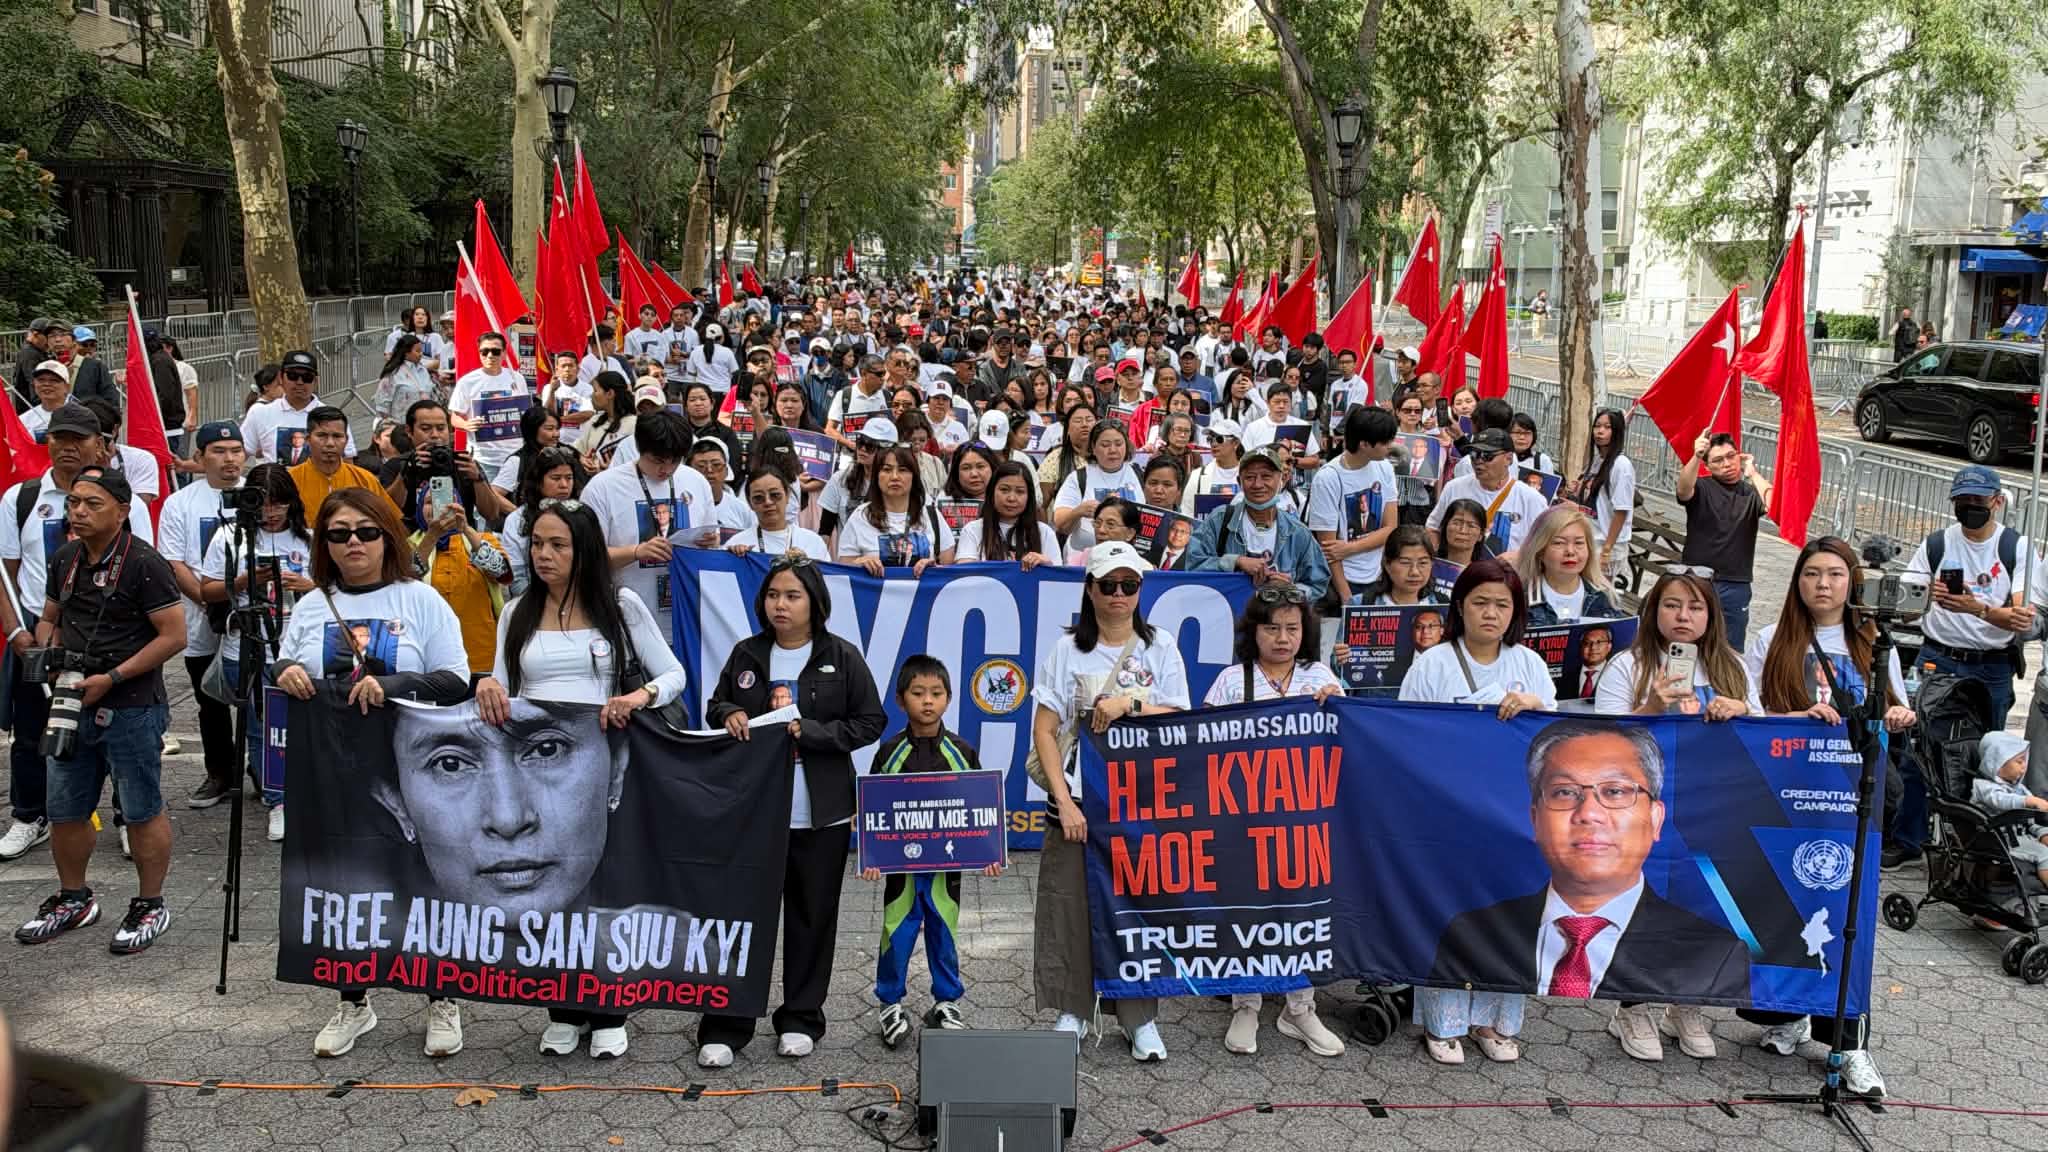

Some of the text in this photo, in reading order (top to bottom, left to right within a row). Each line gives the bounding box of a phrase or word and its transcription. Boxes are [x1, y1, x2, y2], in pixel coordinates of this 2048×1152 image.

[1370, 616, 1400, 630] KYAW
[1377, 632, 1396, 645] TUN
[1107, 711, 1340, 749] OUR UN AMBASSADOR
[1809, 738, 1825, 750] UN
[1107, 745, 1343, 823] H.E. KYAW
[865, 807, 998, 832] H.E. KYAW MOE TUN
[892, 800, 906, 809] OUR
[875, 832, 899, 841] TRUE
[903, 832, 928, 840] VOICE
[1110, 822, 1332, 896] MOE TUN
[302, 885, 753, 977] FREE AUNG SAN SUU KYI
[1116, 916, 1332, 953] TRUE VOICE
[313, 952, 729, 1009] and All Political Prisoners
[1119, 949, 1334, 983] OF MYANMAR
